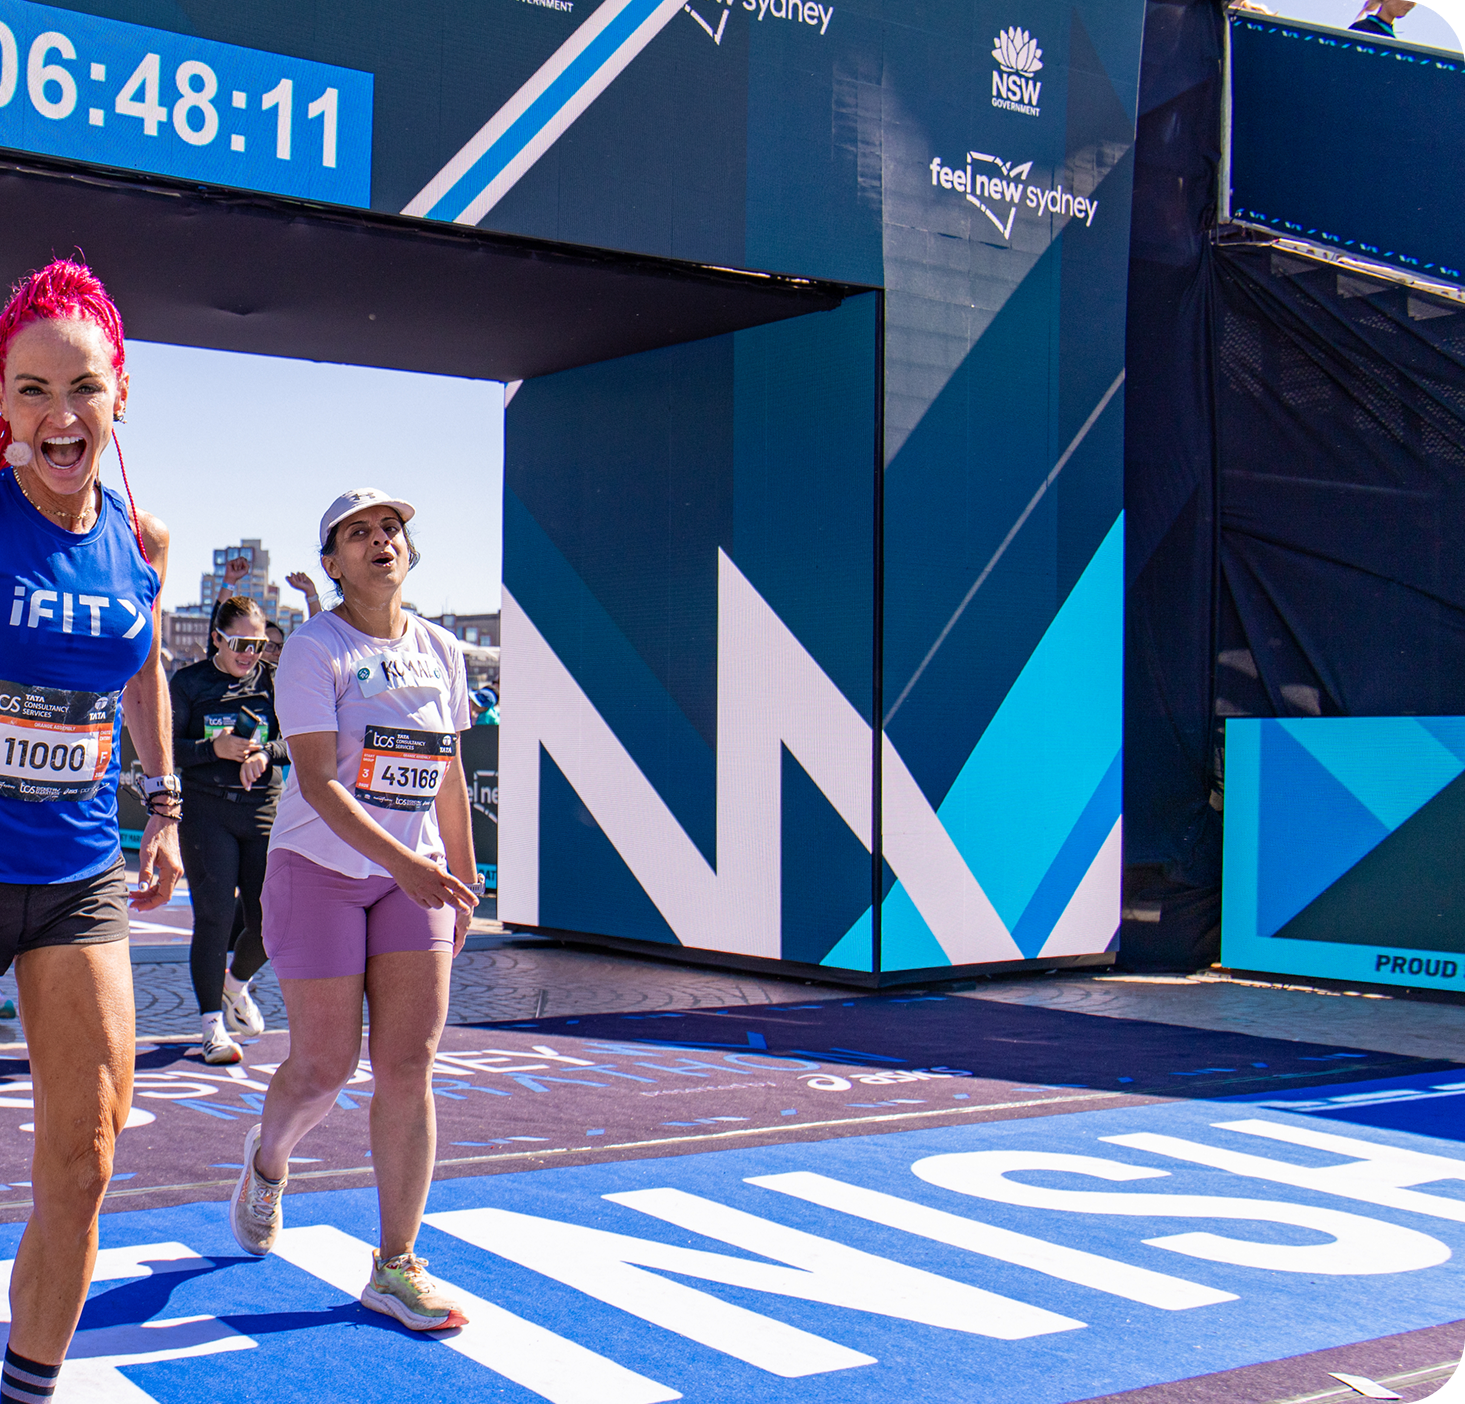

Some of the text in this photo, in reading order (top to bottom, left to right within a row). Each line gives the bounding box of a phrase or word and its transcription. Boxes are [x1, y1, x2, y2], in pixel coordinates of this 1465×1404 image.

[992, 70, 1042, 106] NSW
[991, 97, 1041, 117] GOVERNMENT
[929, 157, 1098, 227] feel new sydney
[9, 586, 110, 636] iFIT
[25, 693, 45, 703] TATA
[22, 708, 52, 718] SERVICES
[23, 701, 70, 713] CONSULTANCY
[89, 711, 106, 720] TATA
[373, 731, 395, 748] tcs
[396, 739, 426, 747] CONSULTANCY
[4, 736, 86, 772] 11000
[100, 751, 108, 764] F
[439, 746, 452, 754] TATA
[362, 768, 370, 778] 3
[381, 765, 439, 789] 43168
[1374, 953, 1458, 979] PROUD
[849, 1066, 973, 1085] asics
